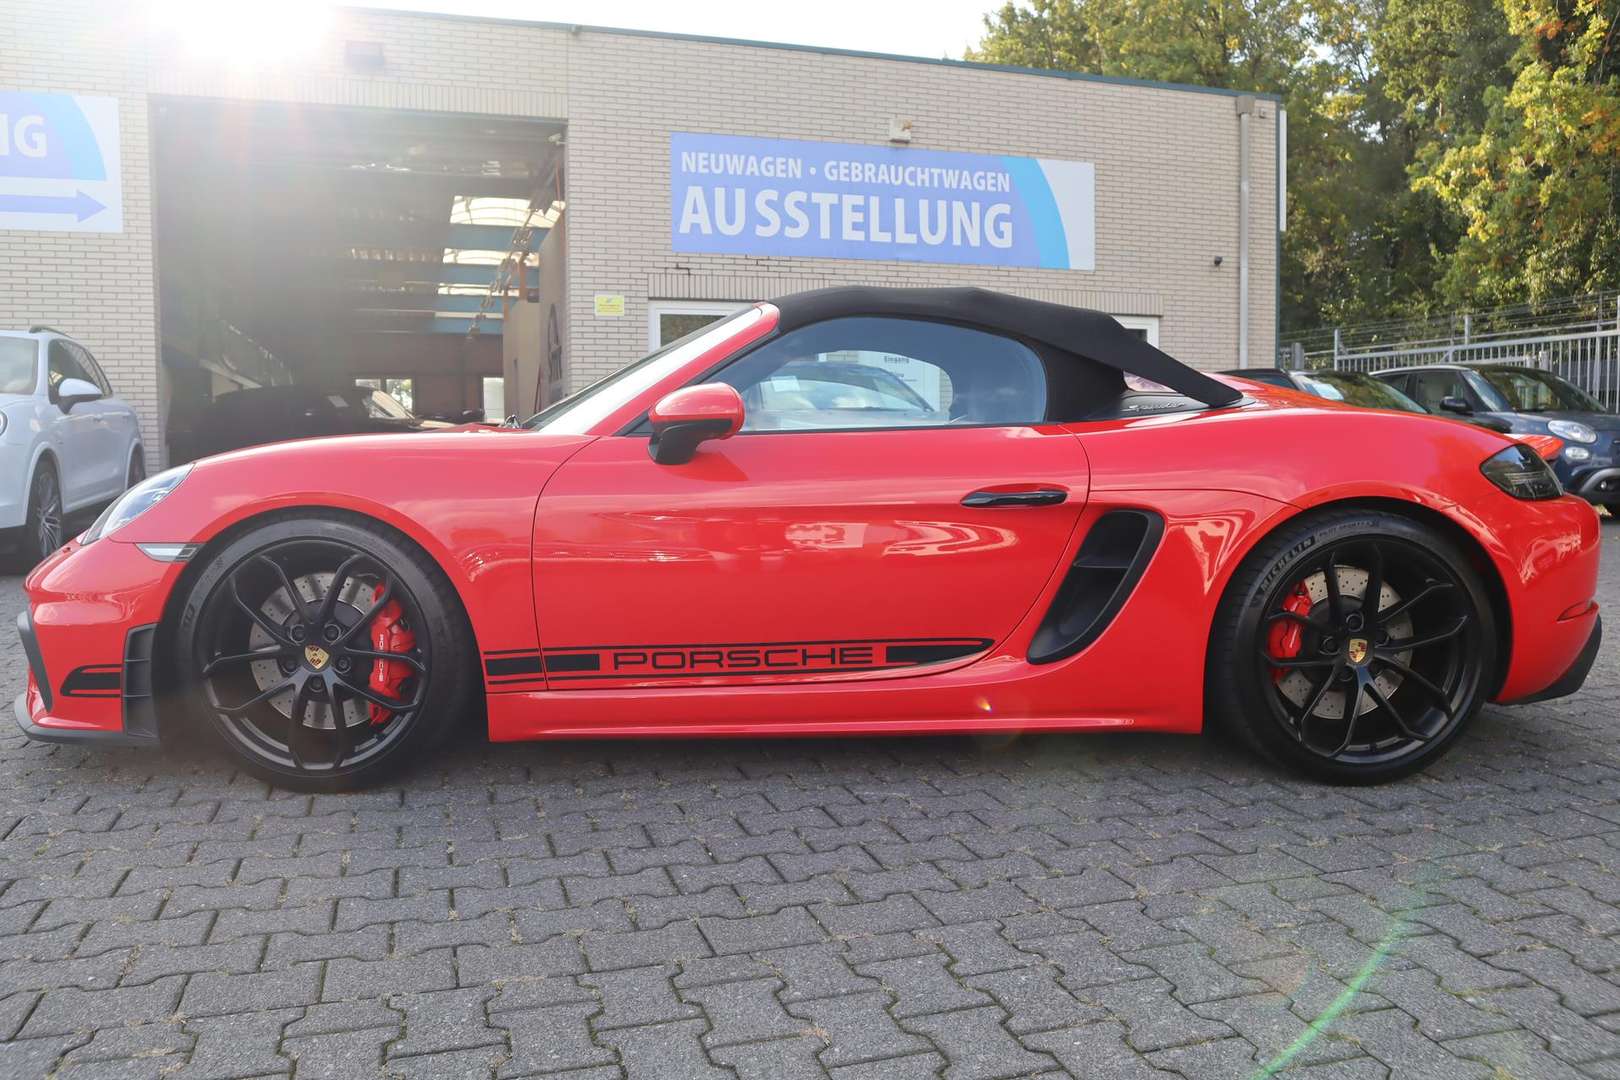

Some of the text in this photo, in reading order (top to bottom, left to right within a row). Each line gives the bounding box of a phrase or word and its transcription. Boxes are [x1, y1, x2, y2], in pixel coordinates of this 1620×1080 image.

[0, 113, 47, 159] G
[681, 151, 1010, 193] NEUWAGEN GEBRAUCHTWAGEN
[678, 186, 1013, 249] AUSSTELLUNG
[1261, 536, 1315, 592] MICHELIN
[613, 647, 873, 670] PORSCHE
